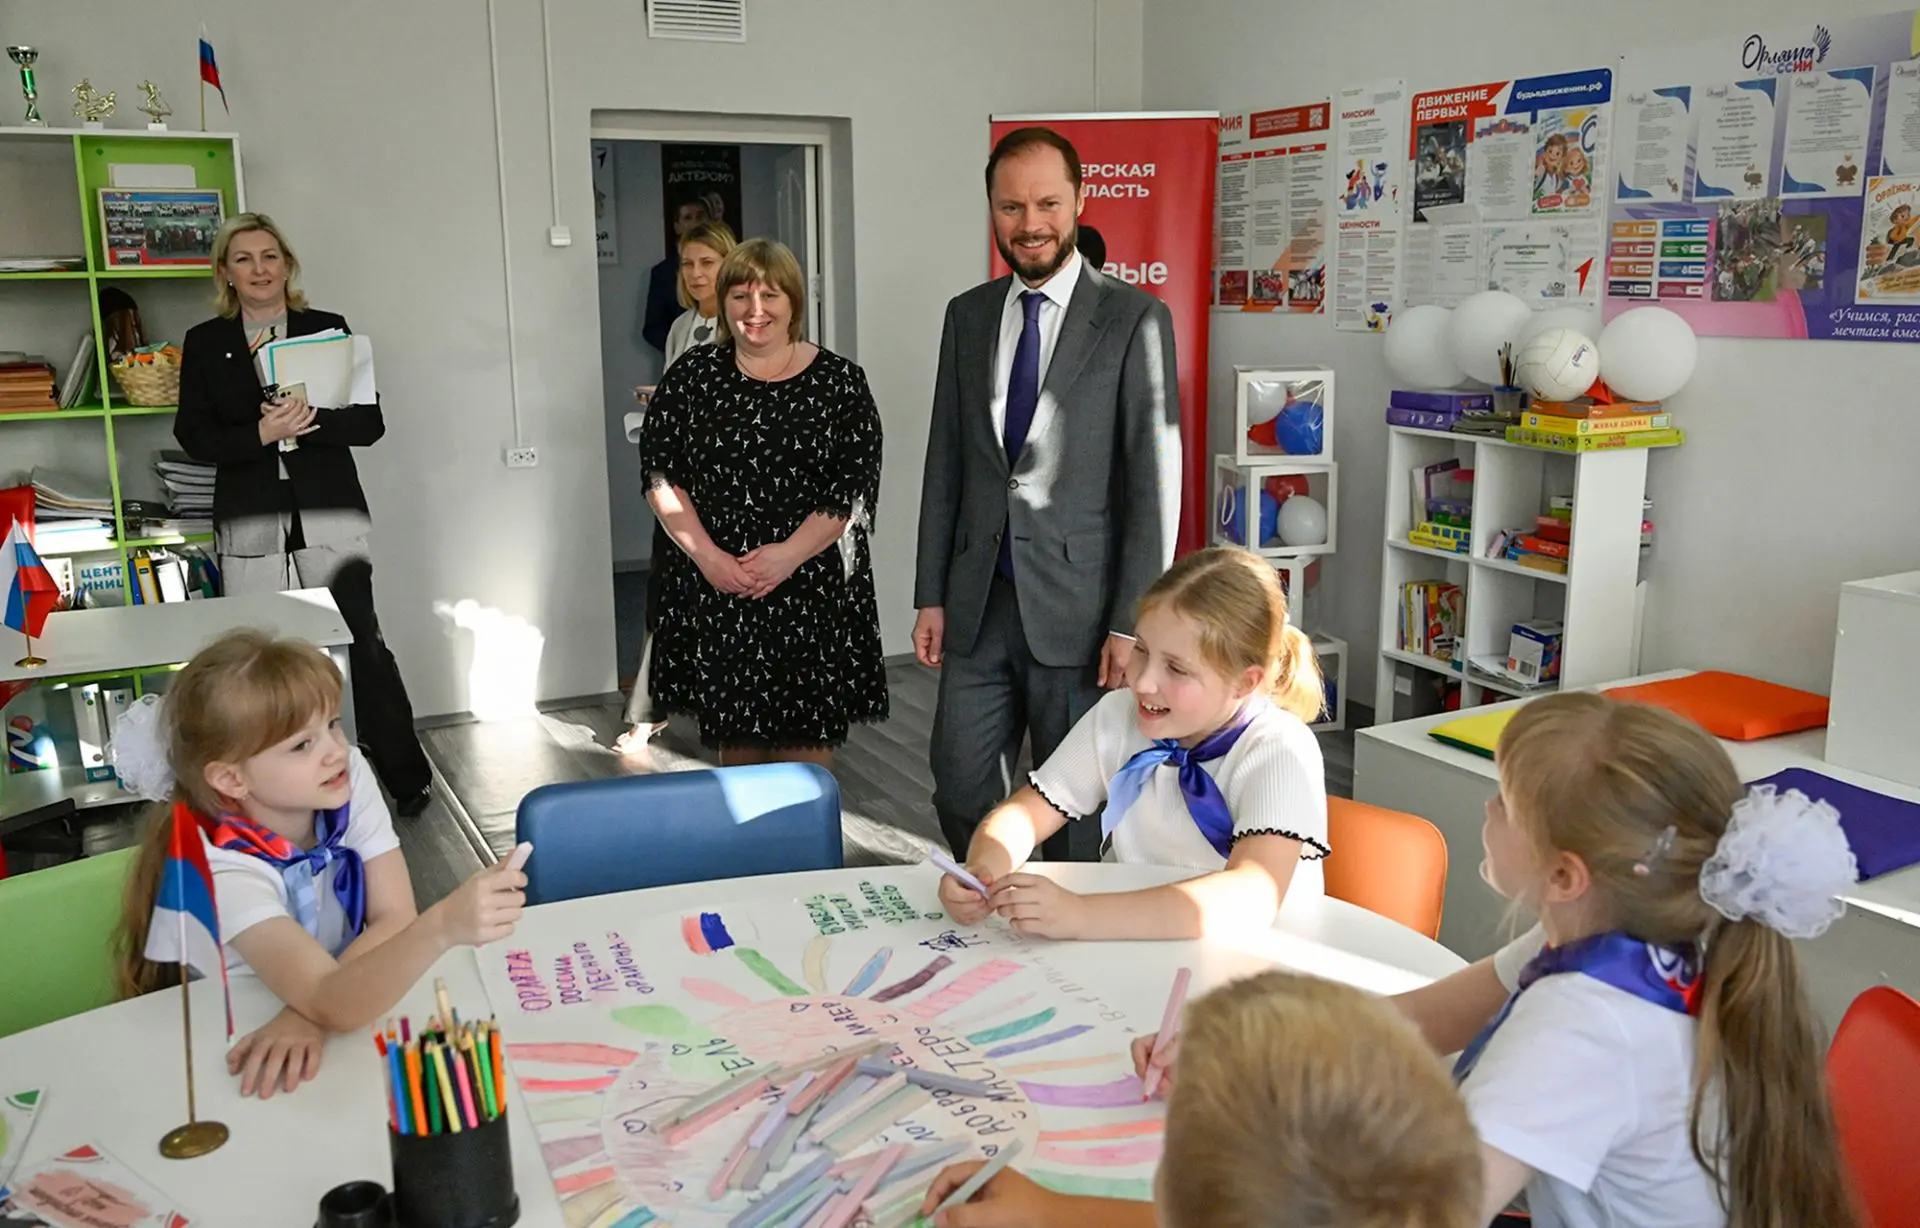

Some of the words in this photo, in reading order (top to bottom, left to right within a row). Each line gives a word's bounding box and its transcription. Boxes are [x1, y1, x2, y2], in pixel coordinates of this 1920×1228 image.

[1742, 34, 1815, 72] Орлята
[1416, 88, 1489, 110] ДВИЖЕНИЕ
[1341, 108, 1376, 120] МИССИИ
[1416, 105, 1469, 121] ПЕРВЫХ
[1220, 115, 1243, 132] МИЯ
[1080, 163, 1156, 178] ЕРСКАЯ
[1084, 183, 1150, 198] ЛАСТЬ
[1338, 220, 1381, 231] ЦЕННОСТИ
[1101, 261, 1168, 285] вые
[1895, 312, 1920, 327] рас
[1831, 327, 1890, 338] мечтаем
[1892, 328, 1920, 339] вмес
